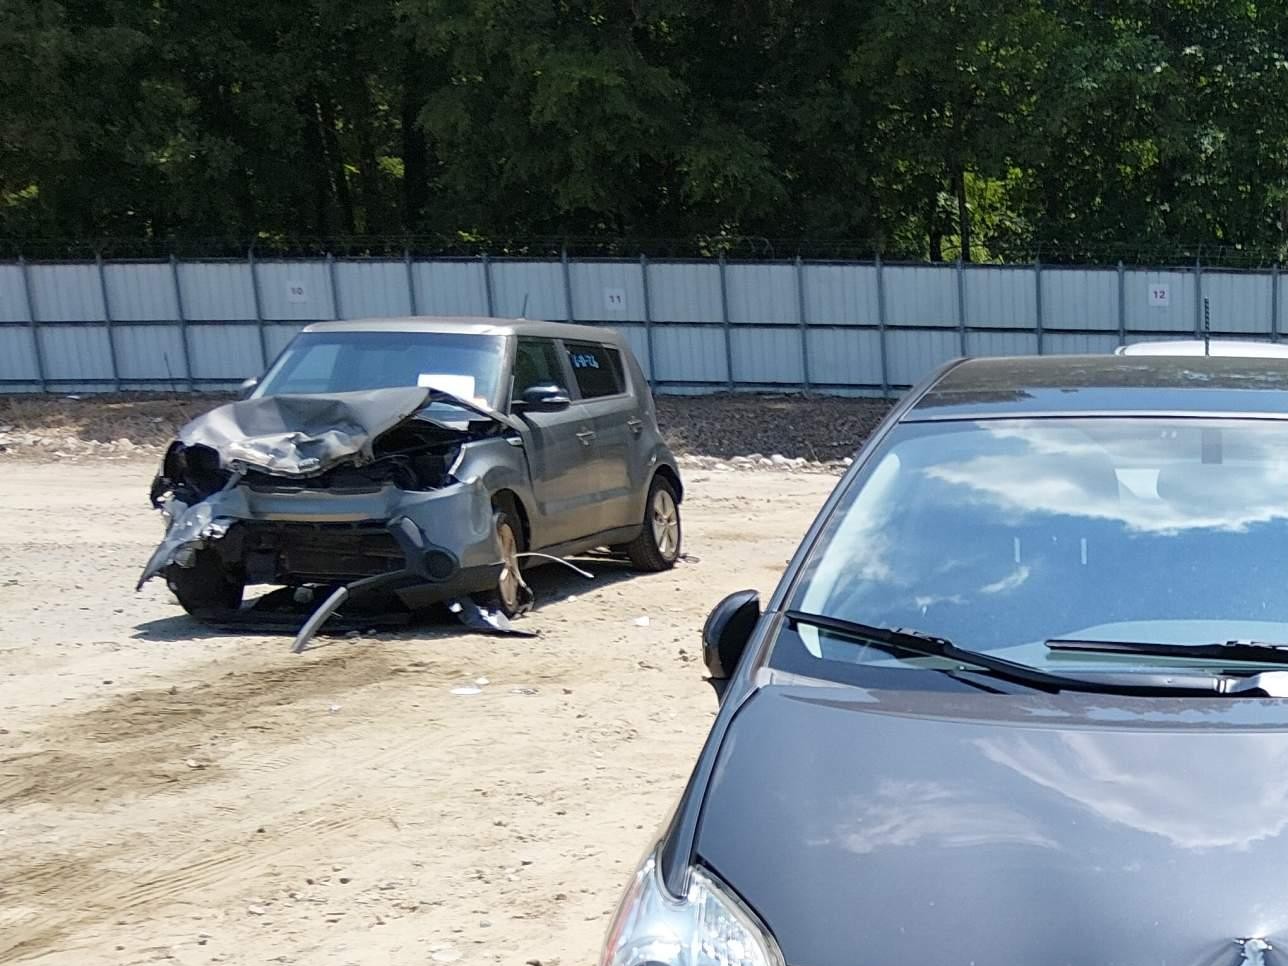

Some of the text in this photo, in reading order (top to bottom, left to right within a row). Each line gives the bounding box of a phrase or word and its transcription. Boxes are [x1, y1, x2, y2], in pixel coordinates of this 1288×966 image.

[290, 286, 305, 296] 10
[1153, 290, 1167, 299] 12
[609, 295, 622, 304] 11
